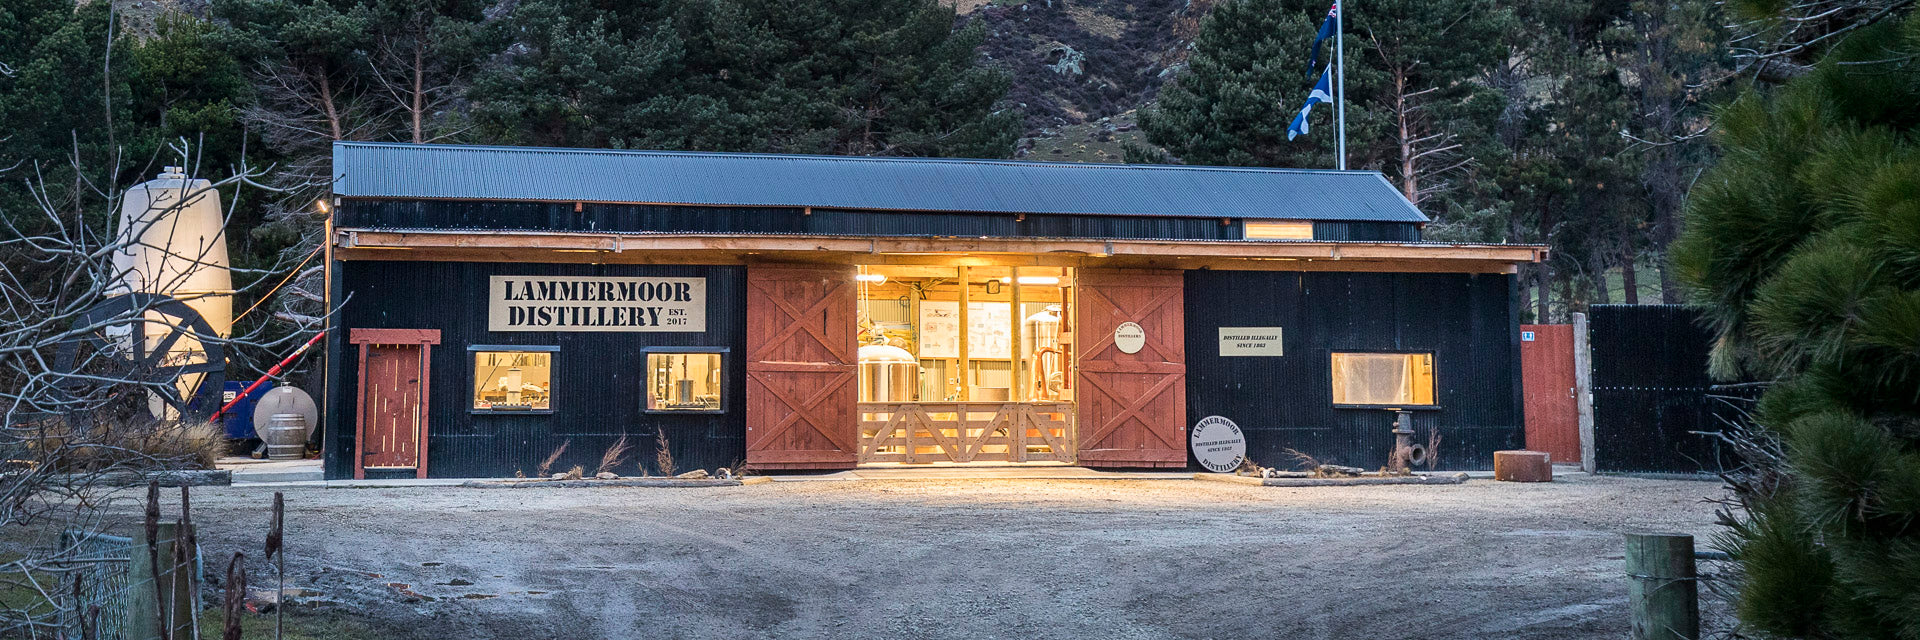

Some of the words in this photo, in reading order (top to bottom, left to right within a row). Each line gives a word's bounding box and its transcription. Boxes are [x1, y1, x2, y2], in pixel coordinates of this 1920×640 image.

[504, 281, 692, 302] LAMMERMOOR
[508, 306, 663, 327] DISTILLERY
[666, 317, 687, 325] 2017
[668, 308, 688, 316] EST.
[1194, 417, 1239, 439] LAMMERMOOR
[1202, 454, 1242, 471] DISTILLERY
